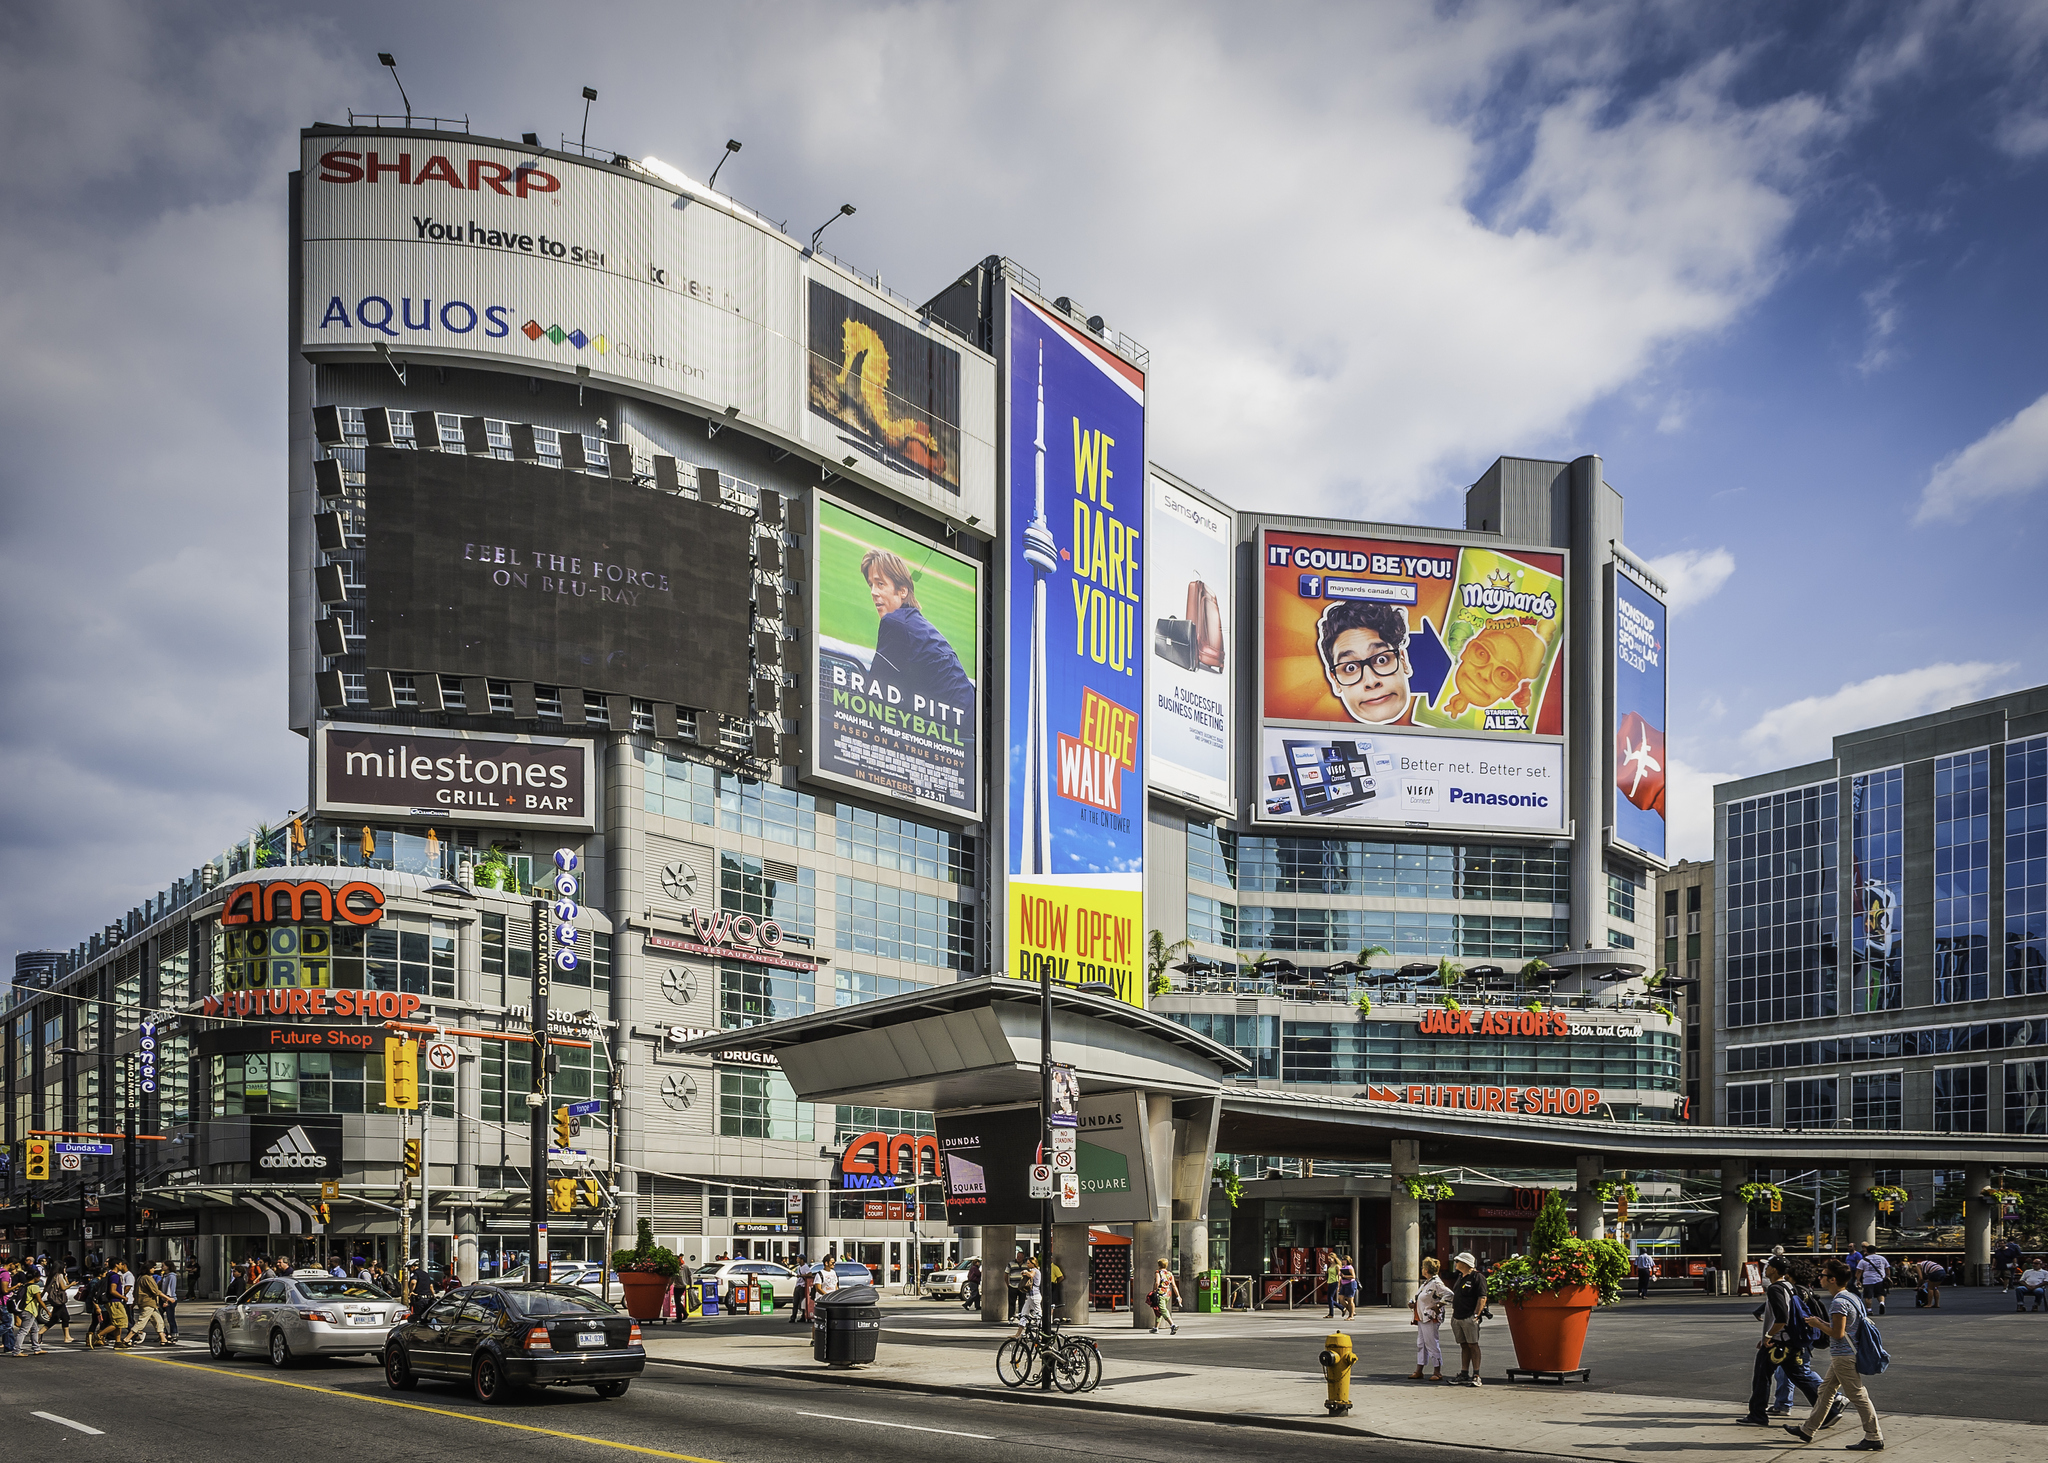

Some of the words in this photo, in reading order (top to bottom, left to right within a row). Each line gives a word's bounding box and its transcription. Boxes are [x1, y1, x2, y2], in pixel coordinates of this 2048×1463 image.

[319, 151, 561, 199] SHARP
[413, 216, 463, 242] You
[469, 221, 533, 252] have
[538, 235, 566, 258] to
[319, 296, 510, 338] AQUOS
[1073, 416, 1115, 511] WE
[1073, 498, 1139, 602] DARE
[1269, 546, 1291, 566] IT
[1294, 548, 1368, 572] COULD
[1371, 554, 1402, 576] BE
[1404, 557, 1452, 579] YOU!
[464, 543, 521, 566] FEEL
[532, 552, 581, 575] THE
[593, 561, 669, 592] FORCE
[493, 570, 528, 589] ON
[542, 575, 642, 607] BLU-RAY
[1330, 585, 1365, 593] maynards
[1072, 577, 1133, 676] YOU!
[1458, 608, 1484, 628] SOUR
[1486, 617, 1519, 630] PATCH
[1618, 597, 1655, 632] NONSTOP
[1618, 612, 1655, 649] TORONTO
[1619, 629, 1634, 650] SFO
[1643, 646, 1658, 667] LAX
[833, 666, 901, 704] BRAD
[914, 694, 964, 725] PITT
[1174, 686, 1179, 699] A
[1180, 688, 1224, 717] SUCCESSFUL
[833, 688, 964, 747] MONEYBALL
[834, 710, 858, 724] JONAH
[859, 719, 874, 730] HILL
[1084, 693, 1135, 766] EDGE
[1158, 694, 1192, 720] BUSINESS
[1194, 709, 1223, 732] MEETING
[1484, 714, 1529, 730] ALEX
[833, 722, 868, 738] BASED
[874, 735, 888, 745] ON
[894, 741, 899, 749] A
[905, 744, 930, 758] TRUE
[935, 754, 965, 768] STORY
[880, 725, 900, 738] PHILIP
[902, 733, 933, 748] SEYMOUR
[933, 741, 964, 758] HOFFMAN
[346, 746, 568, 789] milestones
[1060, 738, 1117, 810] WALK
[1401, 757, 1444, 771] Better
[1449, 762, 1474, 773] net.
[1479, 762, 1522, 776] Better
[1526, 767, 1551, 778] set.
[436, 789, 499, 806] GRILL
[855, 769, 866, 779] IN
[868, 773, 914, 793] THEATERS
[915, 787, 945, 802] 9.23.11
[1450, 787, 1549, 807] Panasonic
[1081, 808, 1087, 821] AT
[1089, 810, 1099, 825] THE
[1101, 811, 1109, 829] CN
[1109, 813, 1131, 834] TOWER
[228, 927, 329, 960] FOOD
[1021, 894, 1068, 953] NOW
[1077, 907, 1131, 966] OPEN!
[538, 908, 548, 996] DOWNTOWN
[656, 938, 696, 949] BUFFET
[704, 947, 767, 962] RESTAURANT
[775, 958, 815, 971] LOUNGE
[223, 989, 326, 1017] FUTURE
[334, 990, 421, 1018] SHOP
[271, 1030, 322, 1045] Future
[327, 1030, 373, 1048] Shop
[547, 1023, 572, 1034] GRILL
[581, 1025, 600, 1036] BAR
[1420, 1009, 1474, 1034] JACK
[1481, 1010, 1568, 1037] ASTOR'S
[1570, 1023, 1594, 1036] Bar
[1596, 1024, 1613, 1036] and
[1617, 1025, 1643, 1038] Grill
[723, 1051, 761, 1063] DRUG
[1408, 1085, 1520, 1113] FUTURE
[1524, 1087, 1600, 1114] SHOP
[65, 1144, 96, 1152] Dundas
[945, 1136, 980, 1146] DUNDAS
[260, 1153, 327, 1168] adidas
[843, 1174, 897, 1188] IMAX
[953, 1183, 983, 1193] SQUARE
[1081, 1178, 1127, 1191] SQUARE
